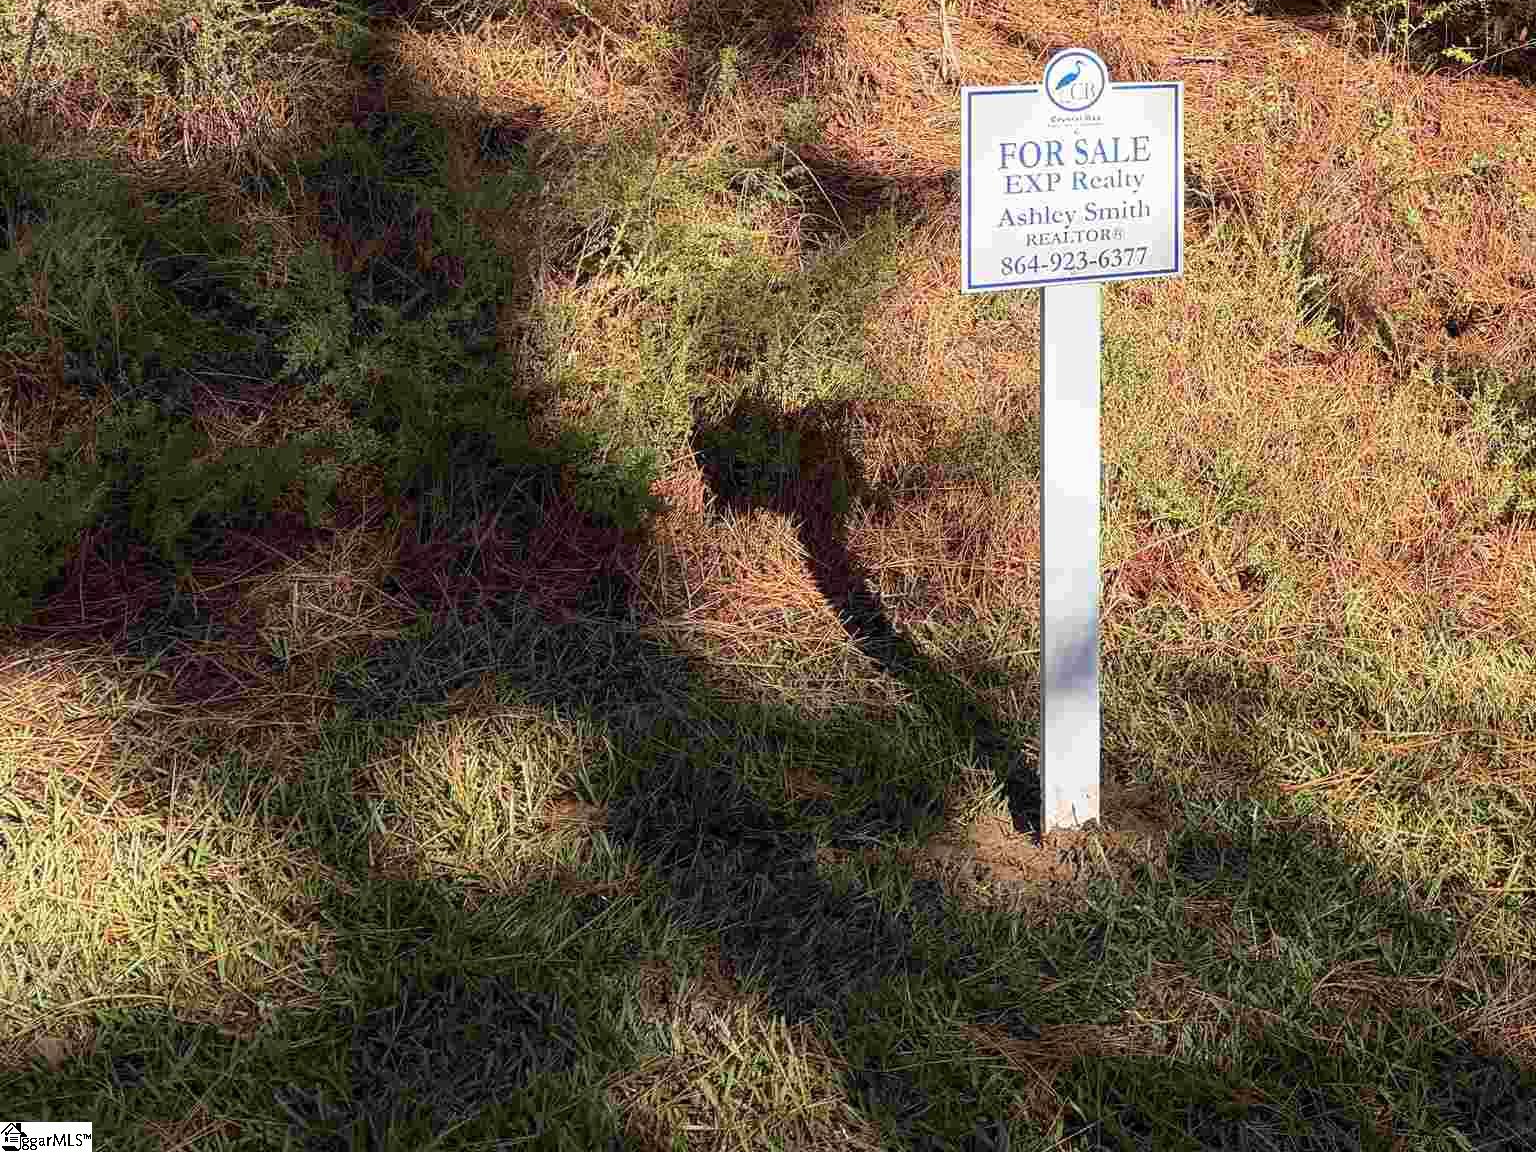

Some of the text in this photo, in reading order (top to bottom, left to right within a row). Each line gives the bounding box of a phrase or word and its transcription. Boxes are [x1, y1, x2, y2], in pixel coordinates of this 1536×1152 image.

[998, 135, 1152, 170] FOR SALE
[1003, 169, 1145, 195] EXP Realty
[998, 199, 1151, 229] Ashley Smith
[1000, 246, 1149, 276] 864-923-6377
